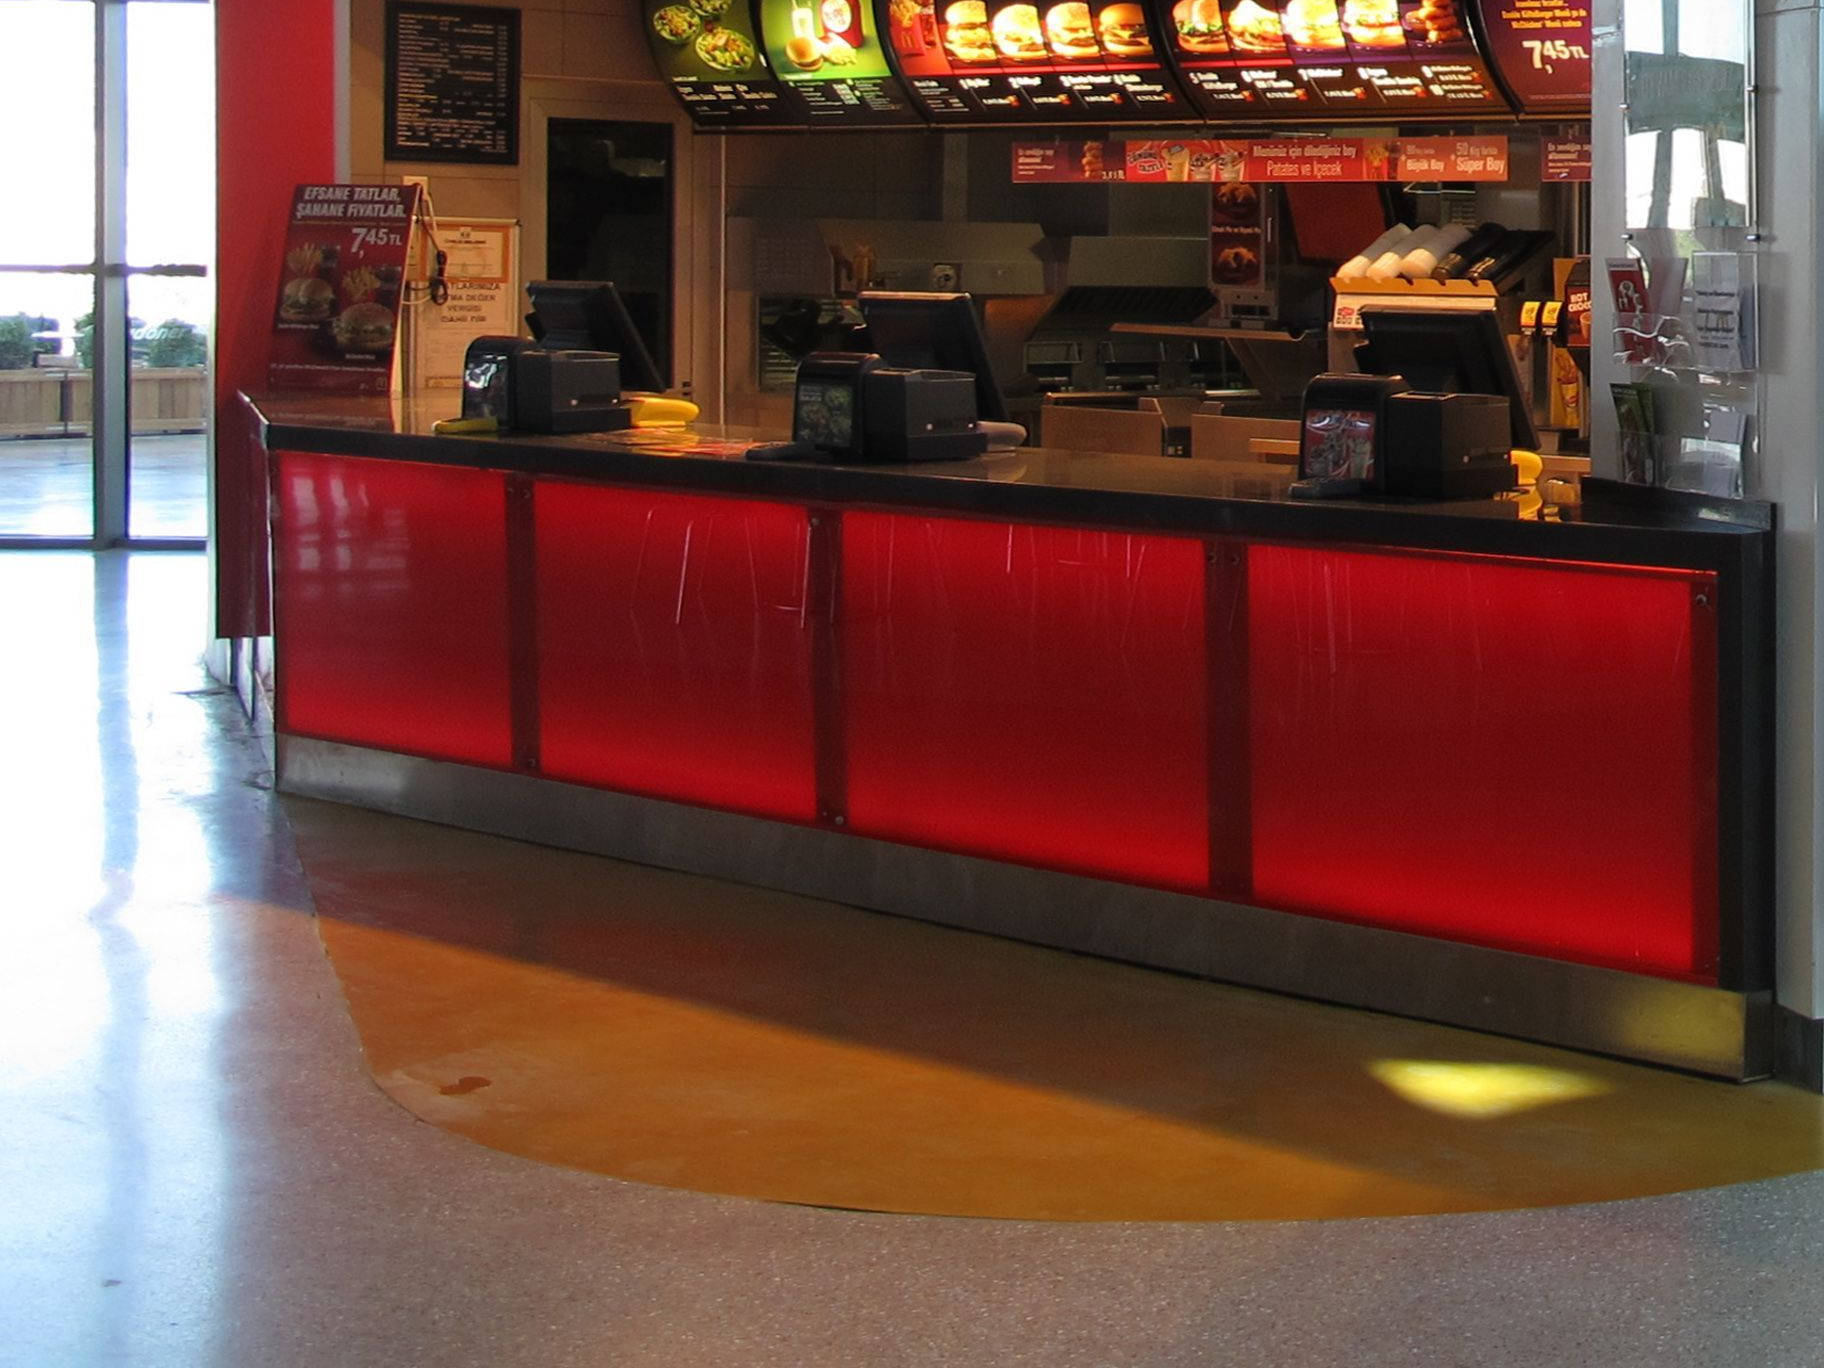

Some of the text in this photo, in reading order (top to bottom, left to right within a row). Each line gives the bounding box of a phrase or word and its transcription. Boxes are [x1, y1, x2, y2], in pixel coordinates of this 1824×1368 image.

[1522, 40, 1570, 74] 7,45
[1267, 160, 1299, 176] Patates
[1487, 157, 1505, 175] Boy
[304, 186, 350, 201] EFSANE
[297, 202, 345, 219] ŞAHANE
[351, 227, 389, 259] 7,45
